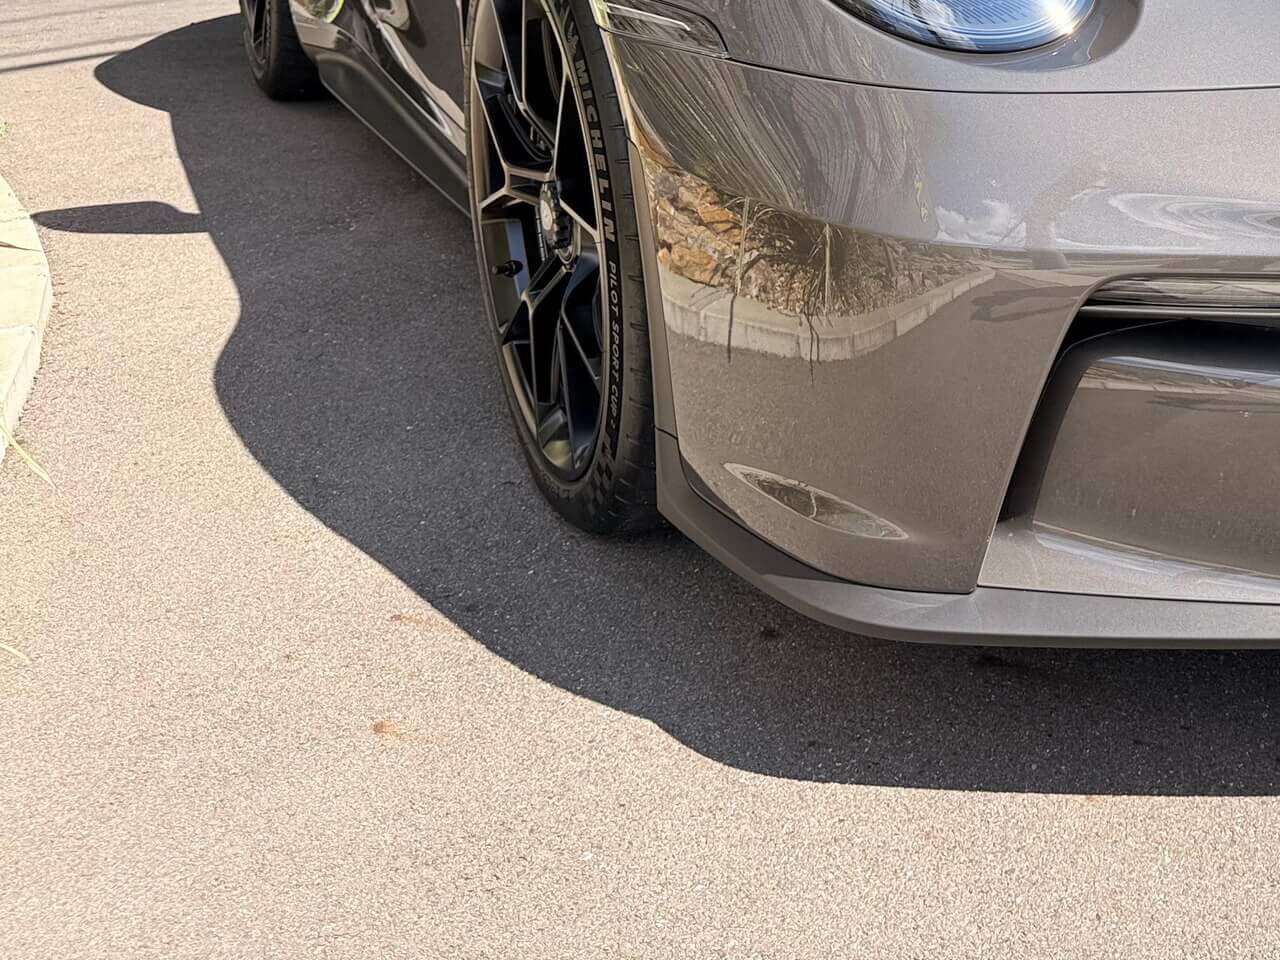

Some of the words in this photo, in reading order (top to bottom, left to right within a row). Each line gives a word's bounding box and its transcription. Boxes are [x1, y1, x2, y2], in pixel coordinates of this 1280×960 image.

[575, 59, 616, 242] MICHELIN
[608, 261, 619, 316] PILOT
[611, 322, 620, 381] SPORT
[610, 384, 619, 415] CUP
